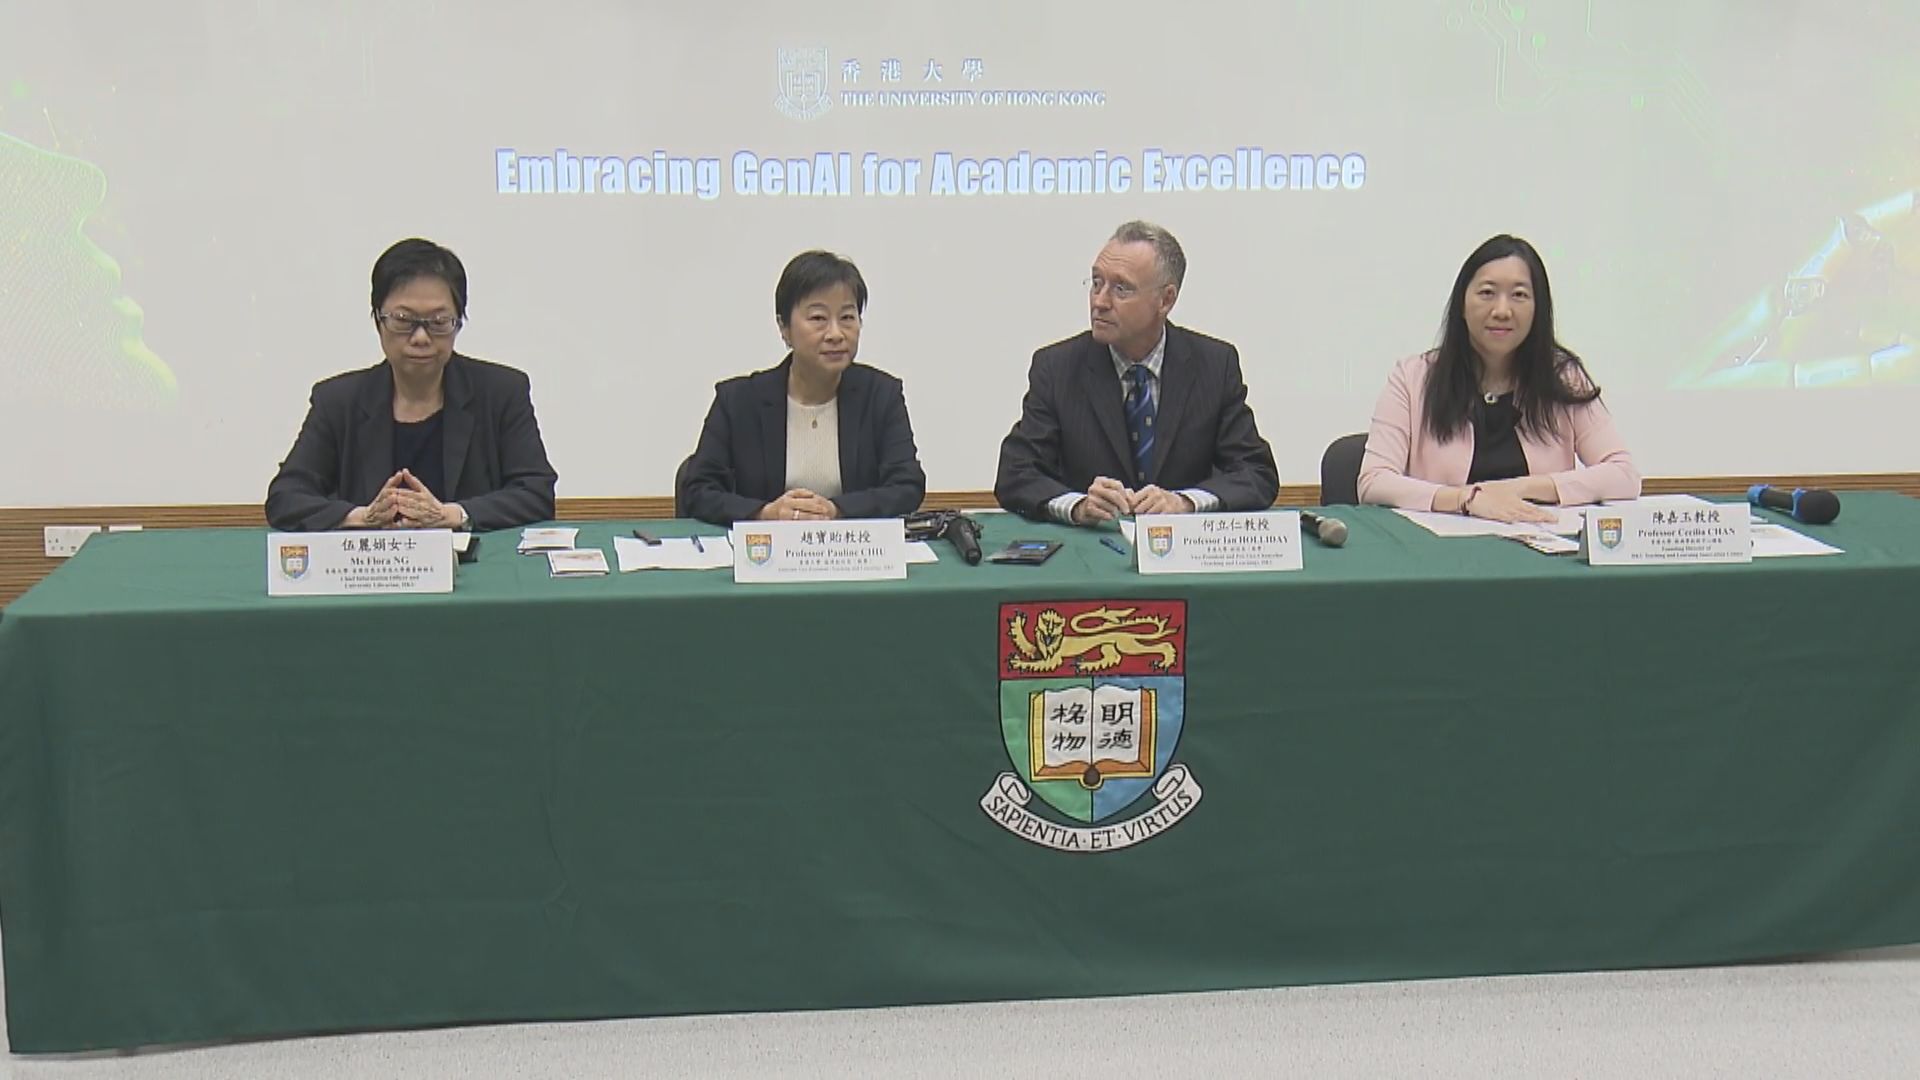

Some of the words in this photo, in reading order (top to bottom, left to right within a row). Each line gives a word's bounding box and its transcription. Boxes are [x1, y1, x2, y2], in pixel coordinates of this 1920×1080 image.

[841, 58, 984, 83] 香港大學
[840, 91, 875, 107] THE
[879, 91, 978, 107] UNIVERSITY
[980, 91, 1003, 107] OF
[1005, 91, 1055, 107] HONG
[1057, 91, 1106, 107] KONG
[495, 148, 720, 200] Embracing
[731, 150, 851, 196] GenAI
[862, 151, 921, 196] for
[930, 150, 1132, 196] Academic
[1142, 147, 1367, 193] Excellence
[1652, 509, 1720, 524] 陳嘉玉教授
[1203, 518, 1270, 532] 何立仁教授
[1638, 529, 1676, 538] Professor
[1678, 528, 1706, 536] Cecilia
[1708, 527, 1736, 535] CHAN
[342, 537, 417, 552] 伍麗娟女士
[1183, 537, 1221, 545] Professor
[1223, 536, 1237, 544] Ian
[1239, 535, 1289, 544] HOLLIDAY
[351, 557, 364, 565] Ms
[367, 556, 391, 565] Flora
[394, 556, 409, 565] NG
[785, 548, 824, 558] Professor
[827, 548, 858, 557] Pauline
[986, 796, 1080, 849] SAPIENTIA
[1091, 830, 1116, 849] ET
[1121, 790, 1193, 840] VIRTUS
